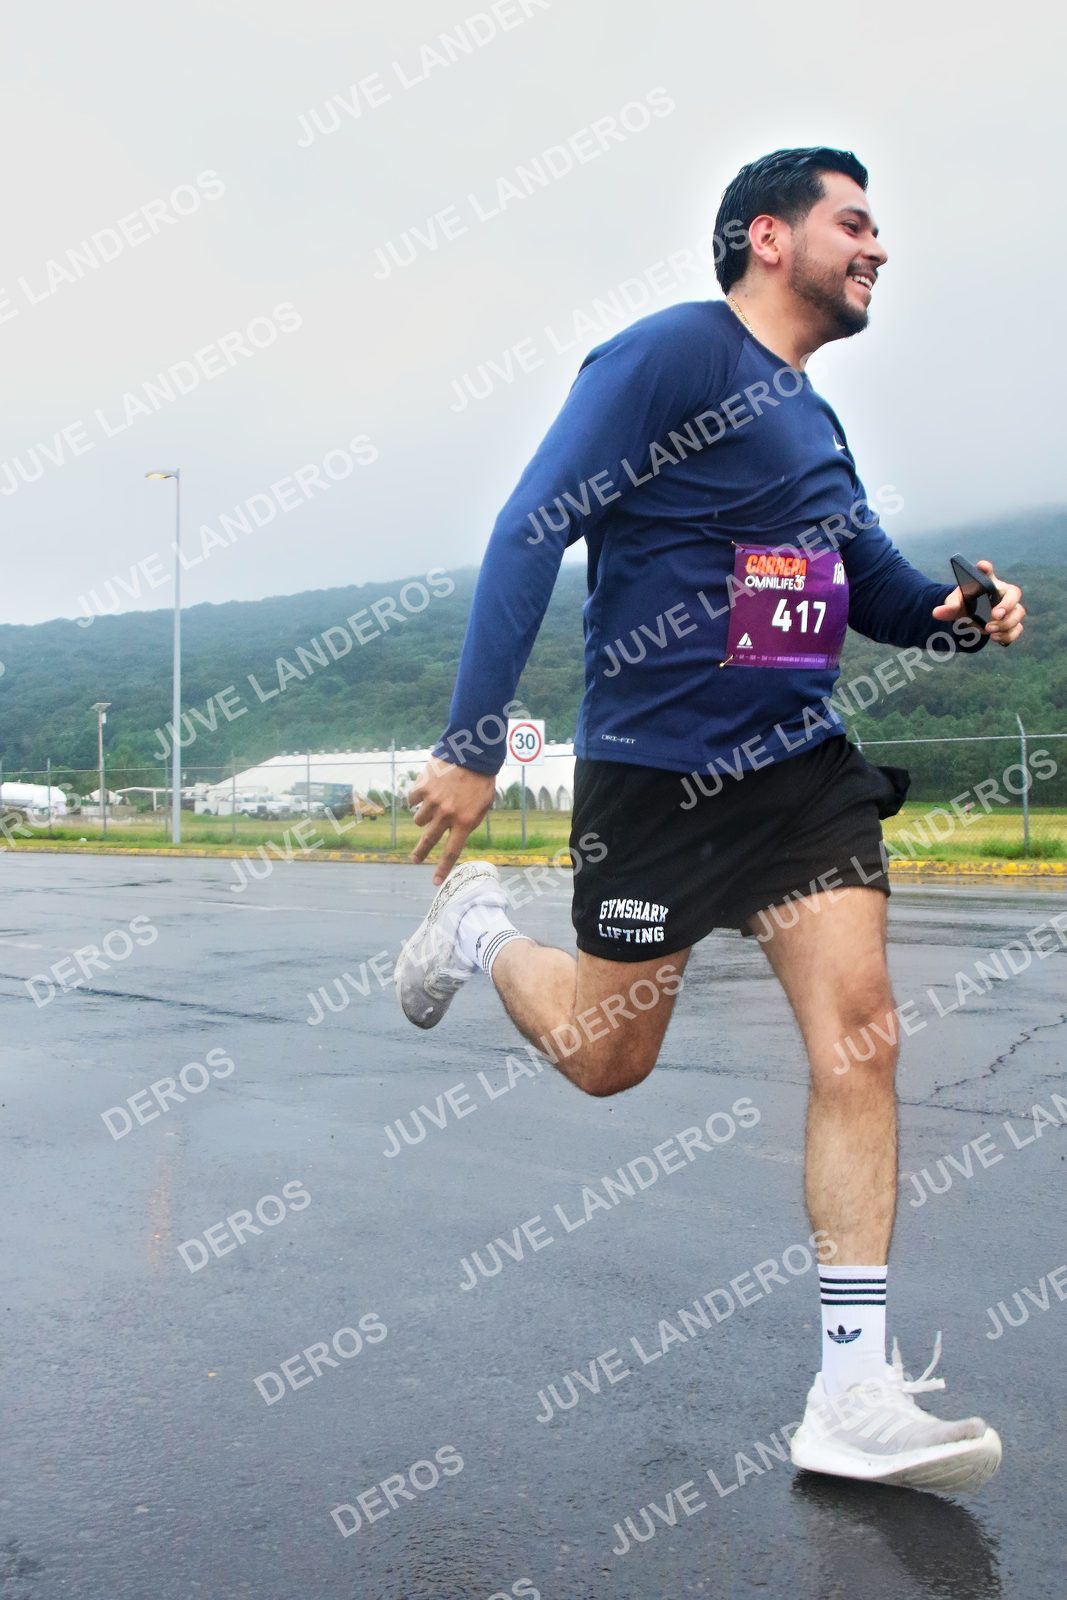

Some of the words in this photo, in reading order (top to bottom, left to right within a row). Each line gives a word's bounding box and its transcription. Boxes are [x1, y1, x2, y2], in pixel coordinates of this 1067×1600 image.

[746, 554, 807, 576] CARRERA
[772, 598, 826, 634] 417
[515, 732, 535, 750] 30
[600, 898, 668, 922] GYMSHARK
[598, 923, 664, 944] LIFTING
